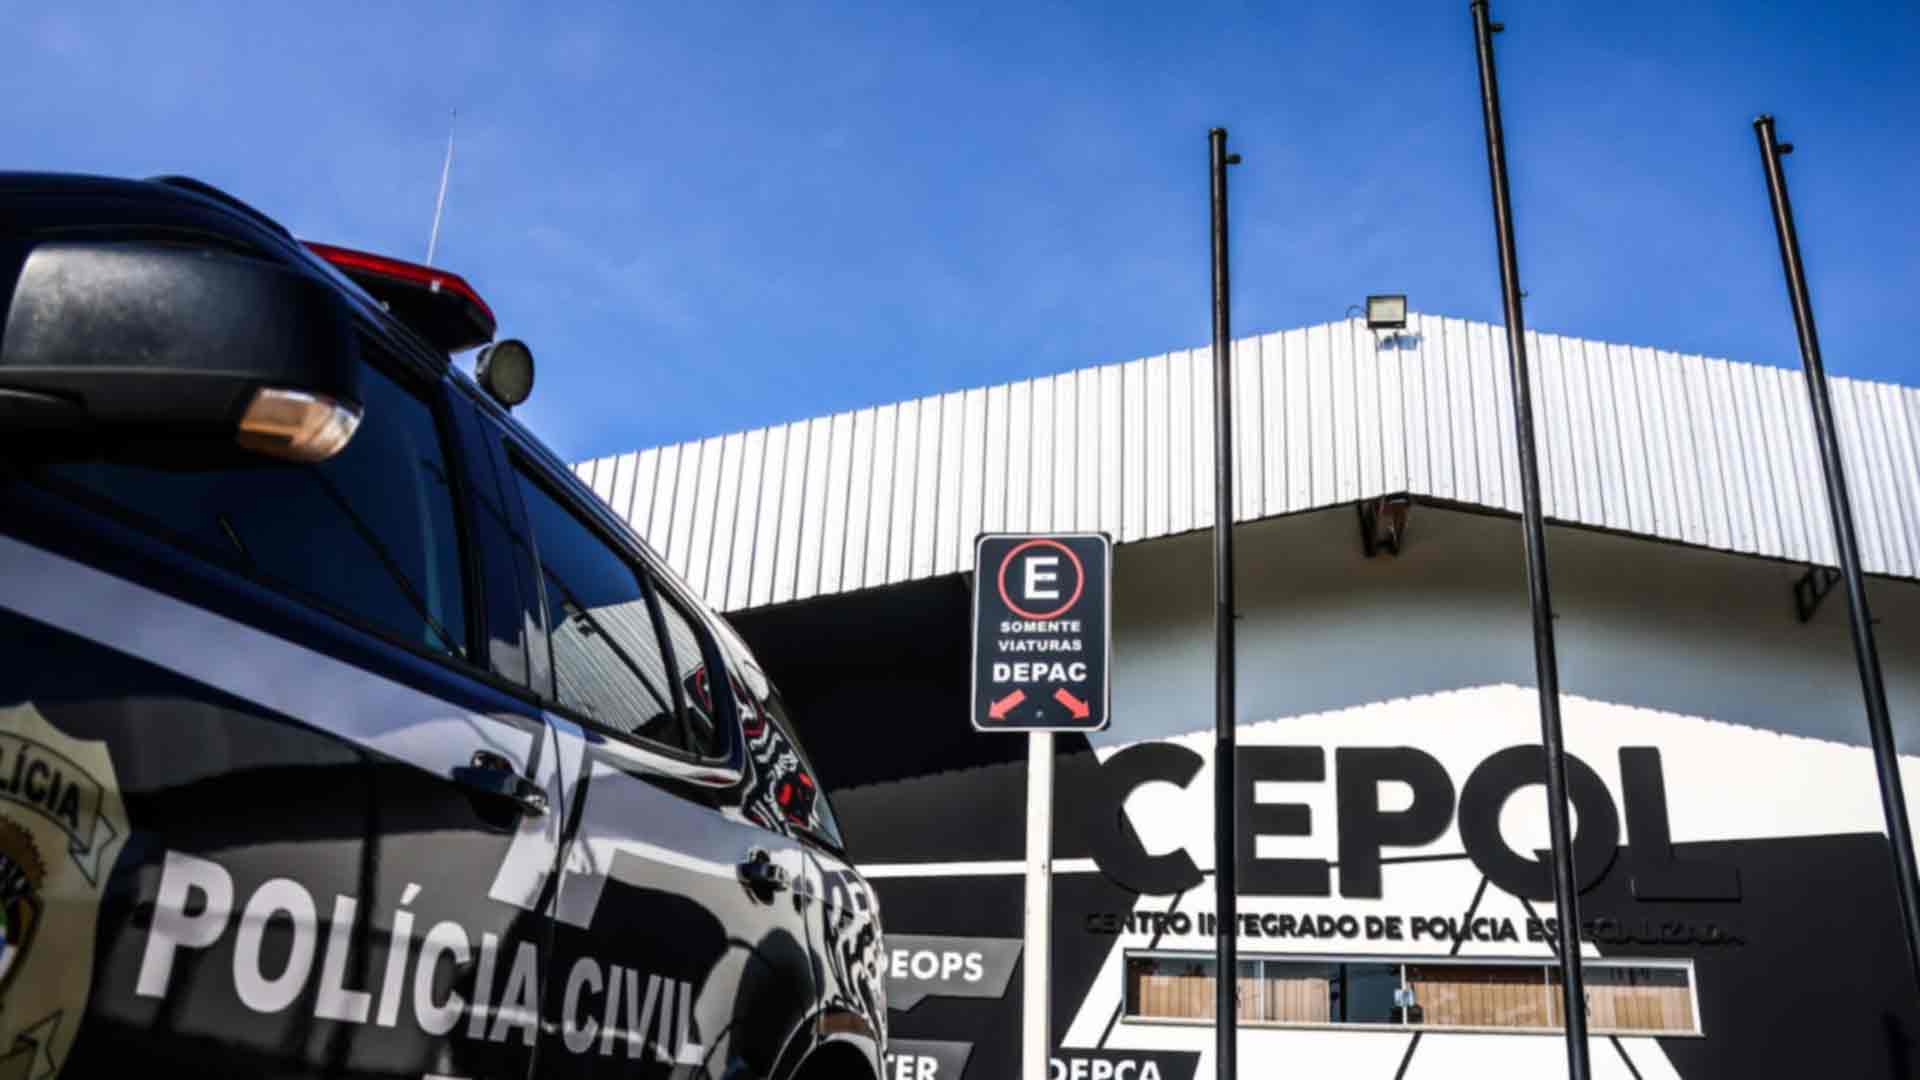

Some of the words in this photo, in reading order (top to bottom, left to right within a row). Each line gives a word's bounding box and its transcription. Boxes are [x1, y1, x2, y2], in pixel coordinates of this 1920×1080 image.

[1024, 555, 1059, 599] E
[1000, 620, 1081, 633] SOMENTE
[998, 639, 1082, 652] VIATURAS
[992, 662, 1088, 682] DEPAC
[1088, 741, 1742, 903] CEPOL
[1086, 910, 1192, 935] CENTRO
[1364, 915, 1404, 941] DE
[136, 849, 539, 1046] POLÍCIA
[561, 956, 705, 1065] CIVIL
[882, 949, 984, 981] EOPS
